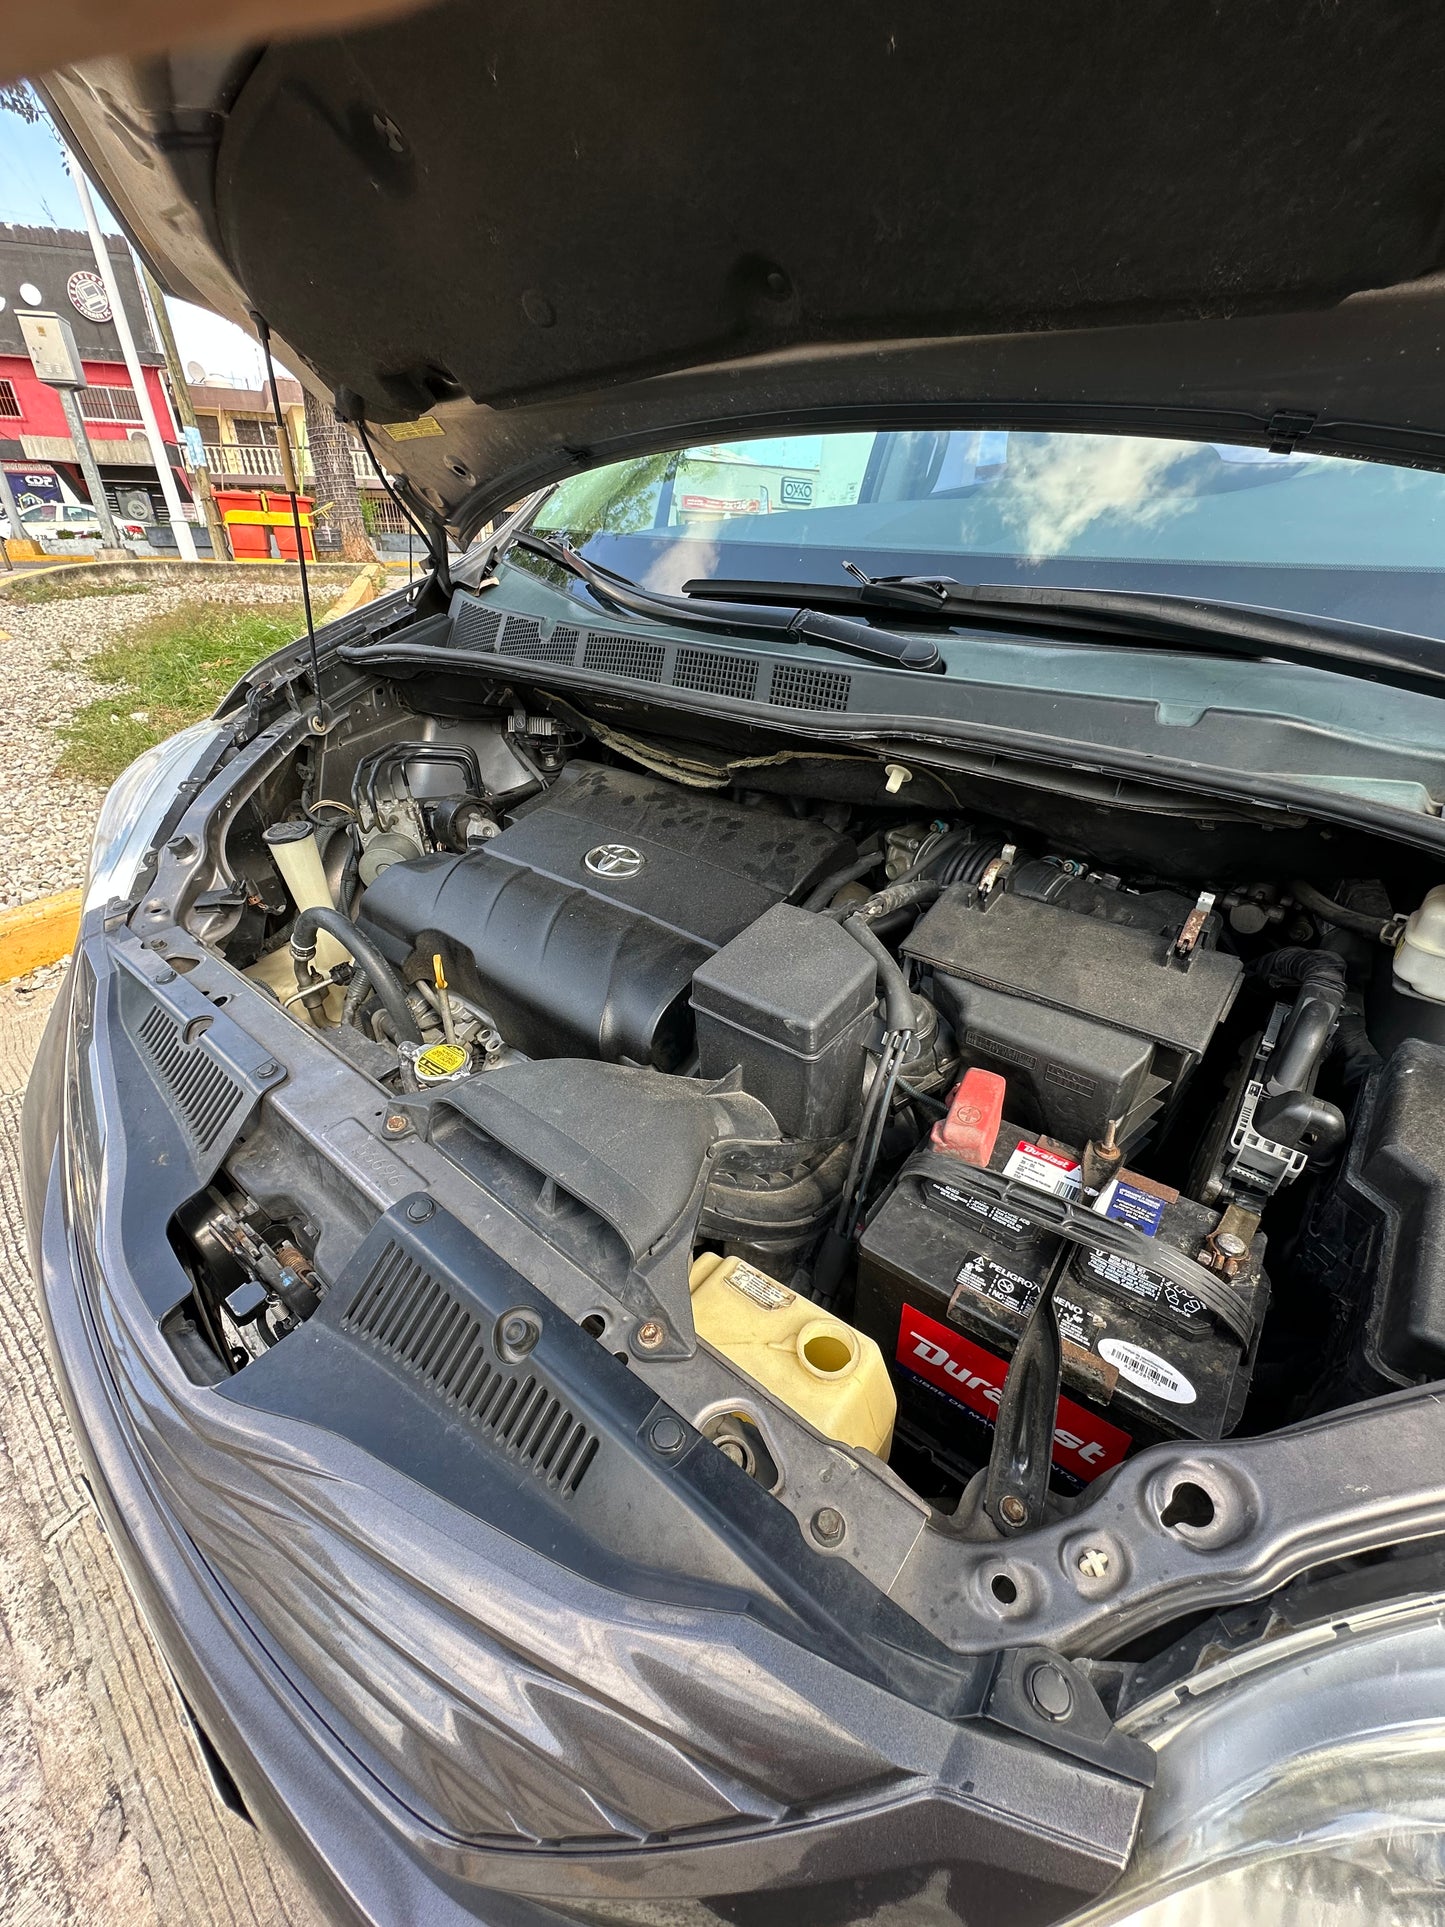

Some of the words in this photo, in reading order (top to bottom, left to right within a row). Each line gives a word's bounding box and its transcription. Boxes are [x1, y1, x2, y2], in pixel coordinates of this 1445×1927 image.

[785, 483, 813, 498] OXXO
[1024, 1144, 1070, 1169] Duralast
[912, 1375, 946, 1398] LIBRE
[948, 1397, 965, 1410] DE
